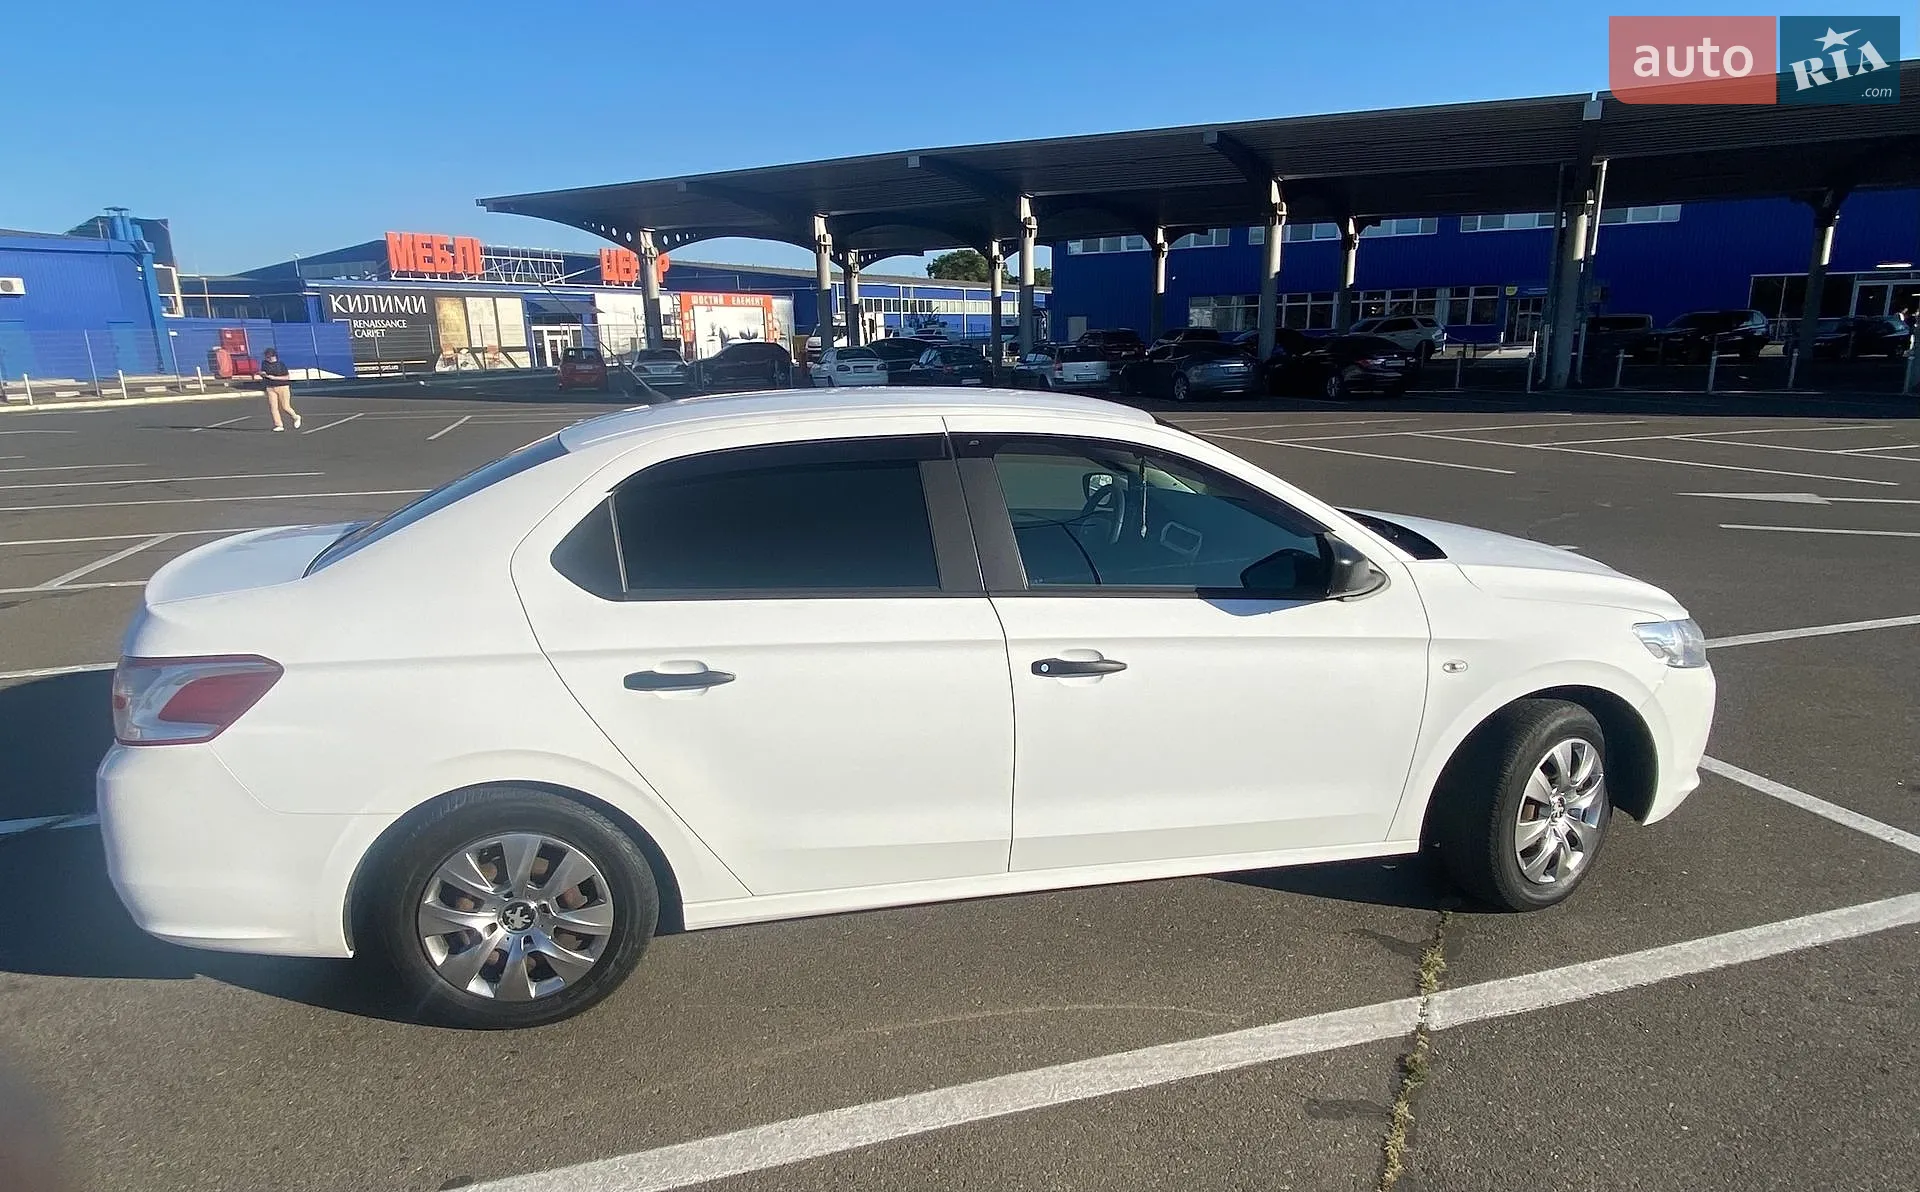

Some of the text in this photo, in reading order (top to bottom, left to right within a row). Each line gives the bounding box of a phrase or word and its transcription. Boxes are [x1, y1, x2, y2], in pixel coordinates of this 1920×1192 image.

[385, 231, 483, 274] МЕБЛІ
[329, 294, 427, 314] КИЛИМИ
[691, 294, 764, 306] ШОСТИЙ ЕЛЕМЕНТ
[353, 319, 407, 329] RENAISSANCE
